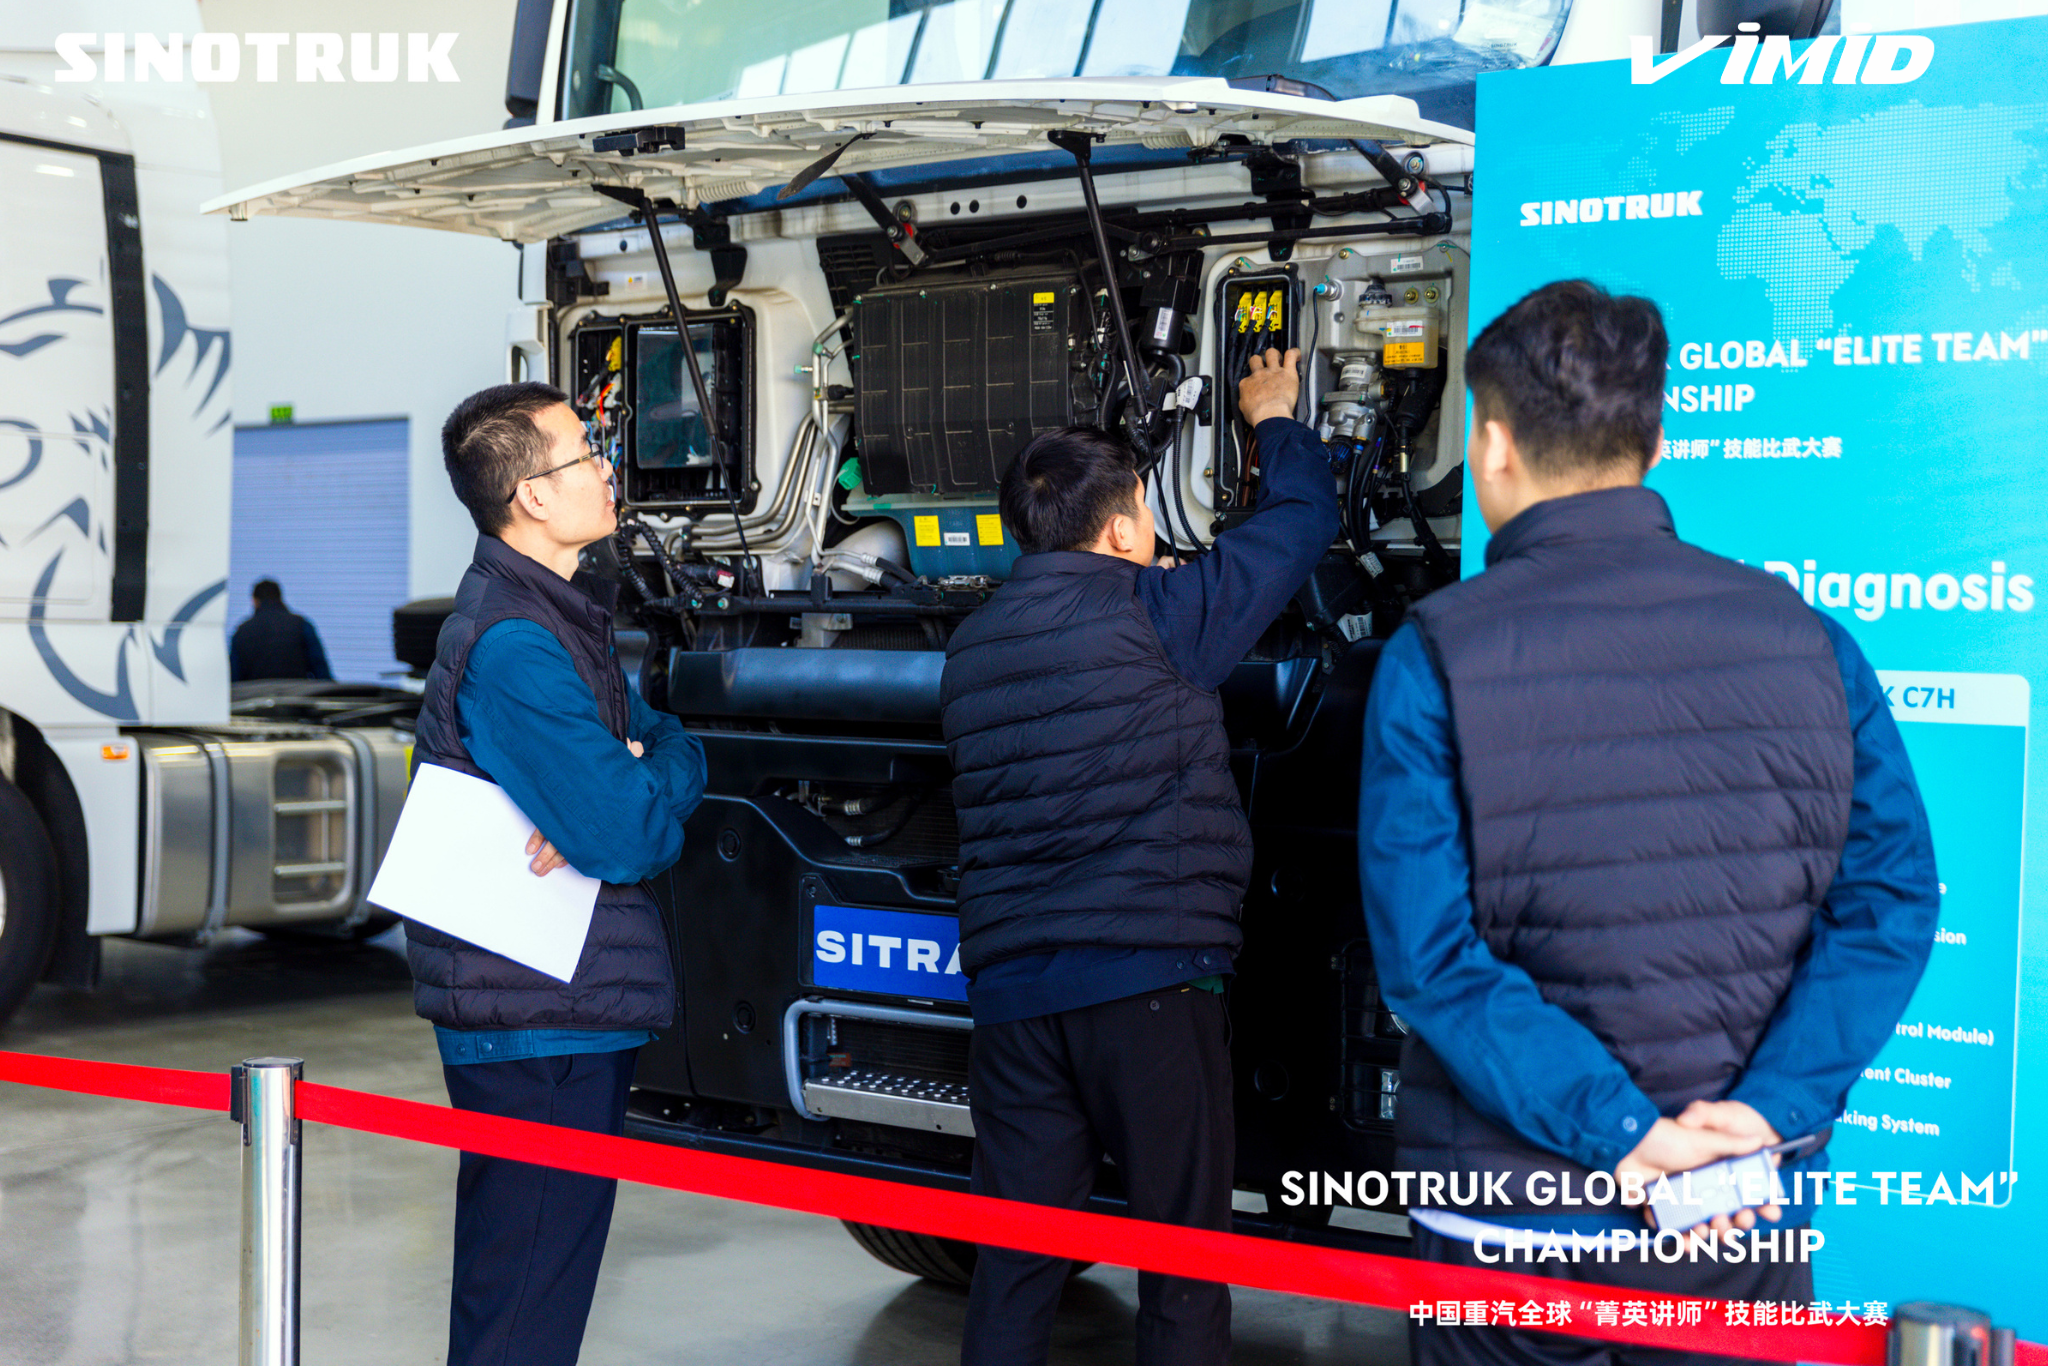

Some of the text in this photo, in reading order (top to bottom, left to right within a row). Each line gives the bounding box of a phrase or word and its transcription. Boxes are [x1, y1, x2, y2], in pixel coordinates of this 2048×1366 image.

[1520, 190, 1703, 227] SINOTRUK
[1679, 339, 1808, 370] GLOBAL
[1663, 384, 1755, 413] NSHIP
[1902, 686, 1955, 709] C7H
[1896, 1021, 1994, 1047] trol Module)
[1894, 1067, 1952, 1089] Cluster
[1881, 1114, 1940, 1137] System
